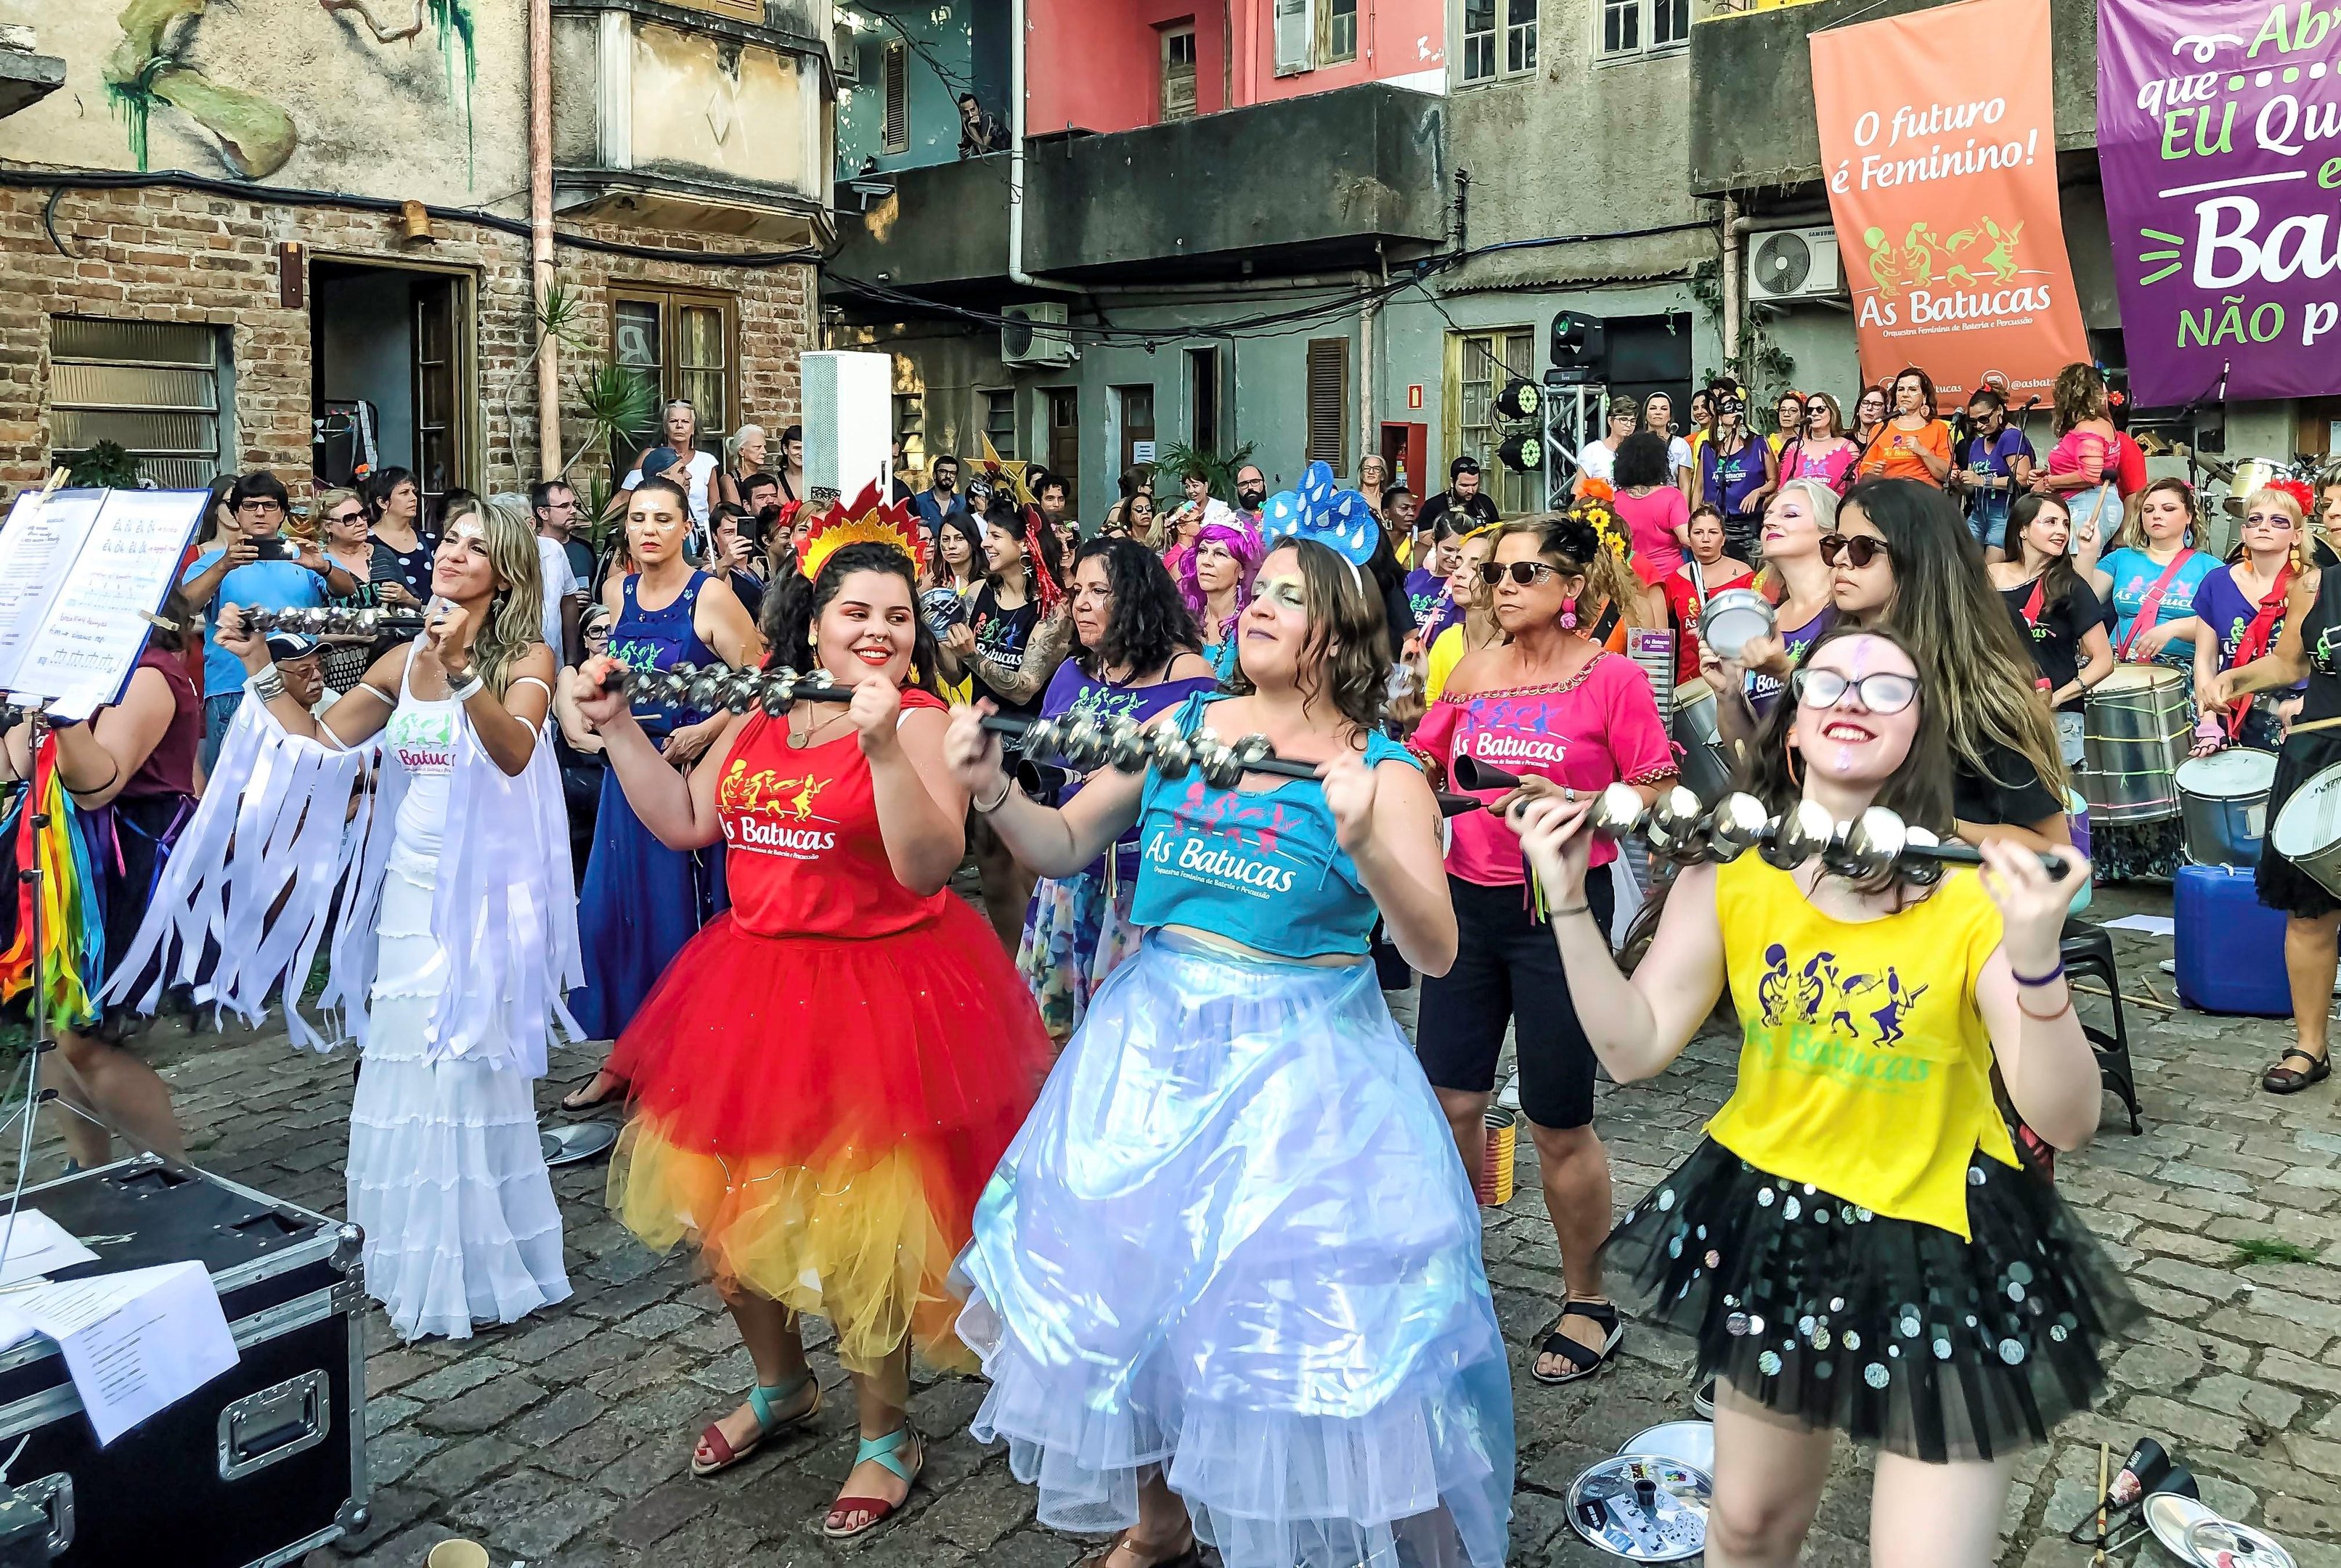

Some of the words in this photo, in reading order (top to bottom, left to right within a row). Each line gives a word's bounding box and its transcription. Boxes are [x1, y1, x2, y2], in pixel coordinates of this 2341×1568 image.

[2136, 71, 2218, 117] que
[1854, 110, 1880, 147] O
[1889, 97, 2006, 147] futuro
[2161, 101, 2238, 160] EU
[2254, 94, 2341, 156] Qu
[1831, 159, 1850, 194] é
[1860, 128, 2038, 191] Feminino!
[2193, 195, 2341, 289] Ba
[1859, 295, 1897, 328] As
[1909, 284, 2051, 324] Batucas
[1883, 329, 1917, 338] Orquestra
[1918, 324, 1950, 335] Feminina
[1961, 320, 1990, 331] Bateria
[1996, 317, 2033, 327] Percussão
[2178, 294, 2284, 347] NÃO
[1935, 385, 1962, 393] tucas
[2011, 377, 2058, 391] @asbat
[2114, 589, 2132, 600] As
[1685, 618, 1697, 629] As
[1452, 734, 1470, 759] As
[1475, 732, 1567, 762] Batucas
[740, 816, 836, 851] Batucas
[1144, 830, 1175, 863] As
[1178, 837, 1297, 893] Batucas
[1154, 865, 1179, 875] Orquestra
[1180, 870, 1205, 883] Feminina
[1214, 879, 1235, 891] Bateria
[1240, 886, 1271, 901] Percussão
[1788, 1024, 1929, 1082] Batucas
